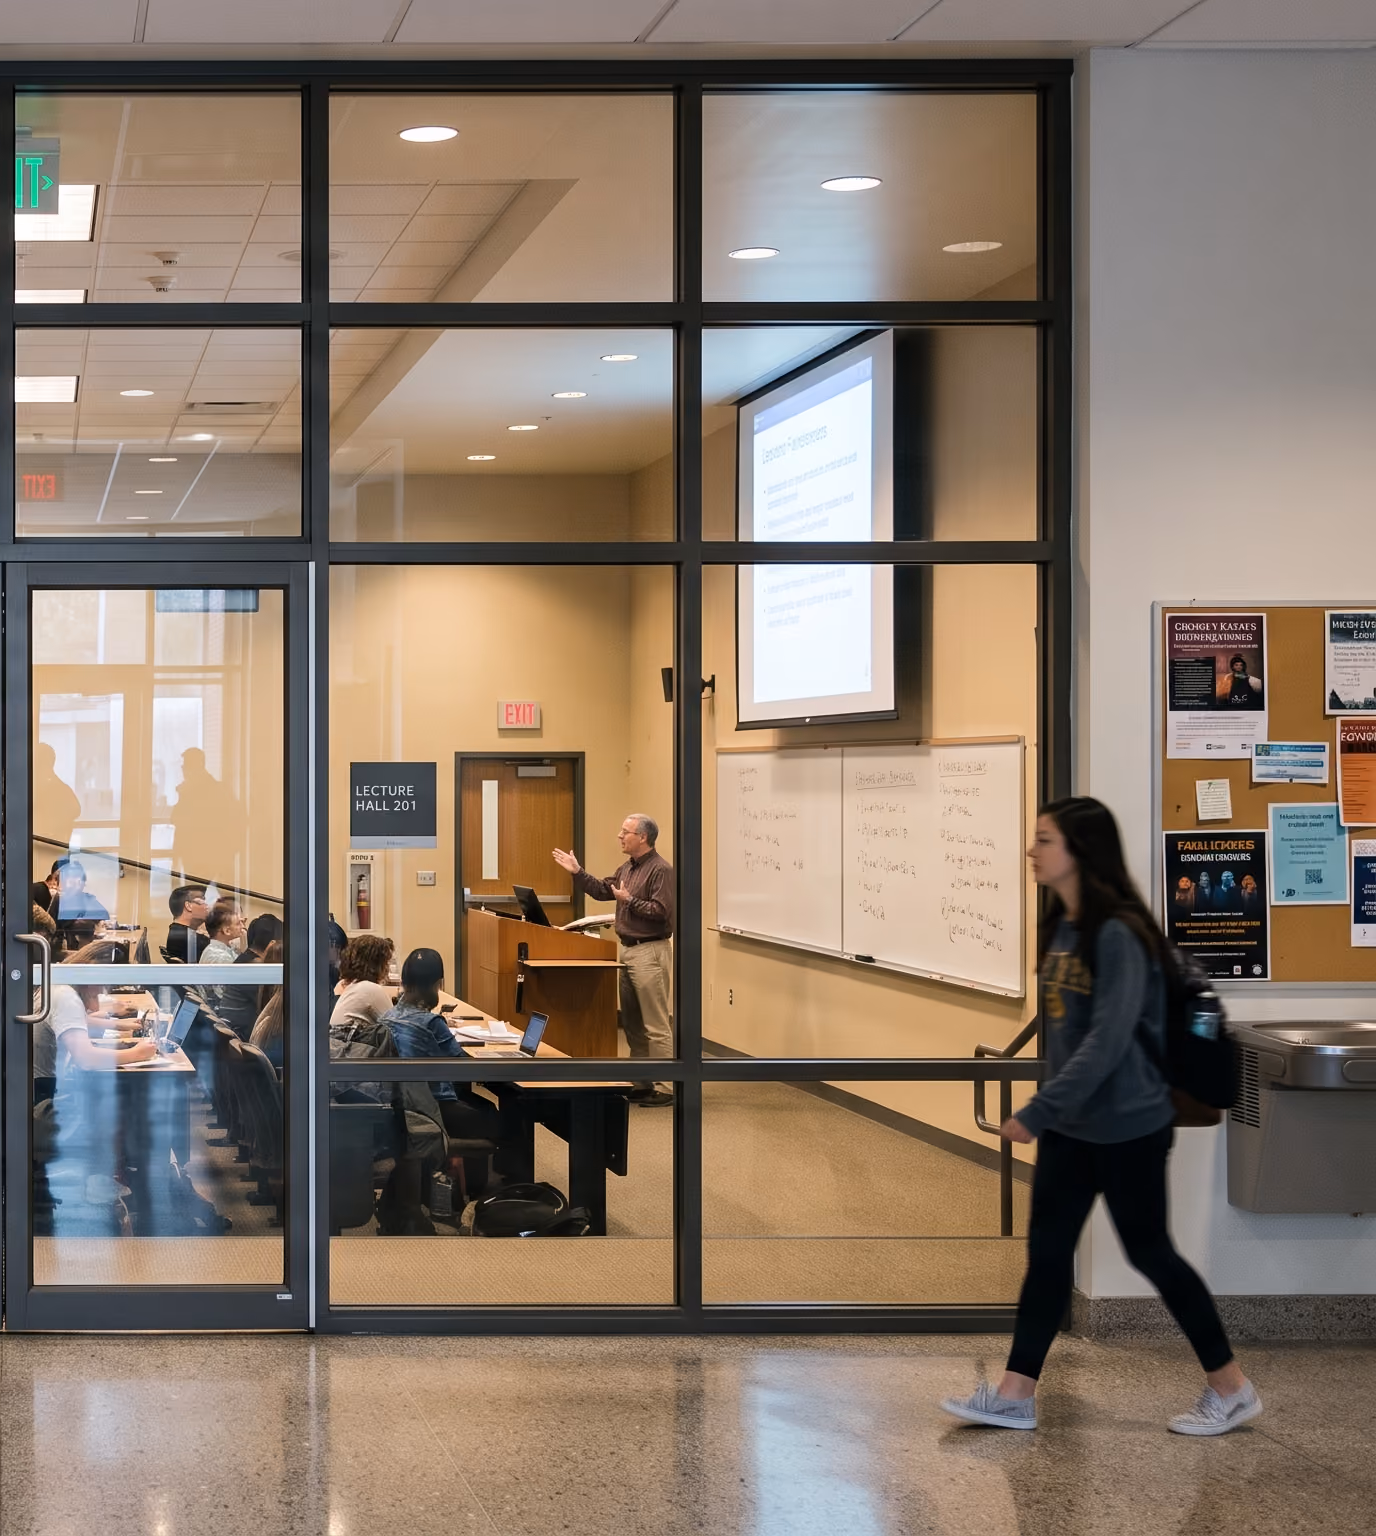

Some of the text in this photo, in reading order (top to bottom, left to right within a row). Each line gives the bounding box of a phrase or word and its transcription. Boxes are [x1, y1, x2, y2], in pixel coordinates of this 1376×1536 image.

[505, 703, 534, 725] EXIT
[355, 785, 415, 796] LECTURE
[355, 800, 416, 811] HALL 201
